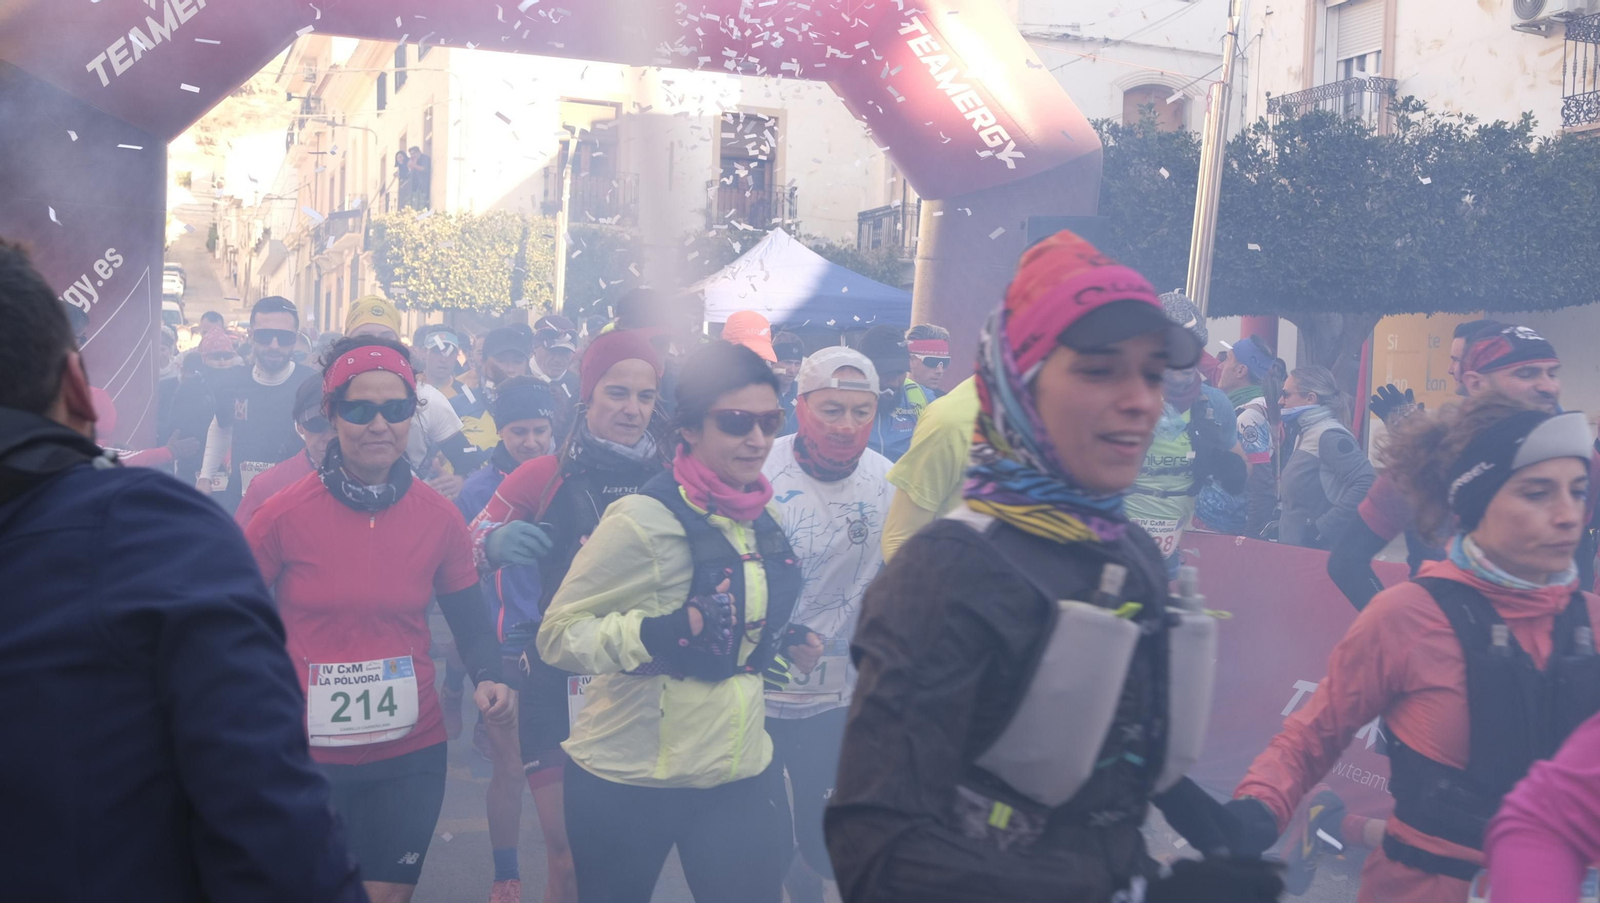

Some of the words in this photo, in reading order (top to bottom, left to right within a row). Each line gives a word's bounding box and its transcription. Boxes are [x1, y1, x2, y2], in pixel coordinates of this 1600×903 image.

[85, 0, 207, 88] TEAME
[897, 15, 1026, 169] TEAMERGY
[58, 247, 124, 314] gy.es
[1386, 333, 1399, 350] Si
[1426, 371, 1447, 391] tan
[323, 665, 334, 674] IV
[337, 664, 363, 674] CxM
[319, 677, 331, 686] LA
[334, 674, 381, 685] PÓLVORA
[582, 676, 592, 685] IV
[330, 685, 398, 723] 214
